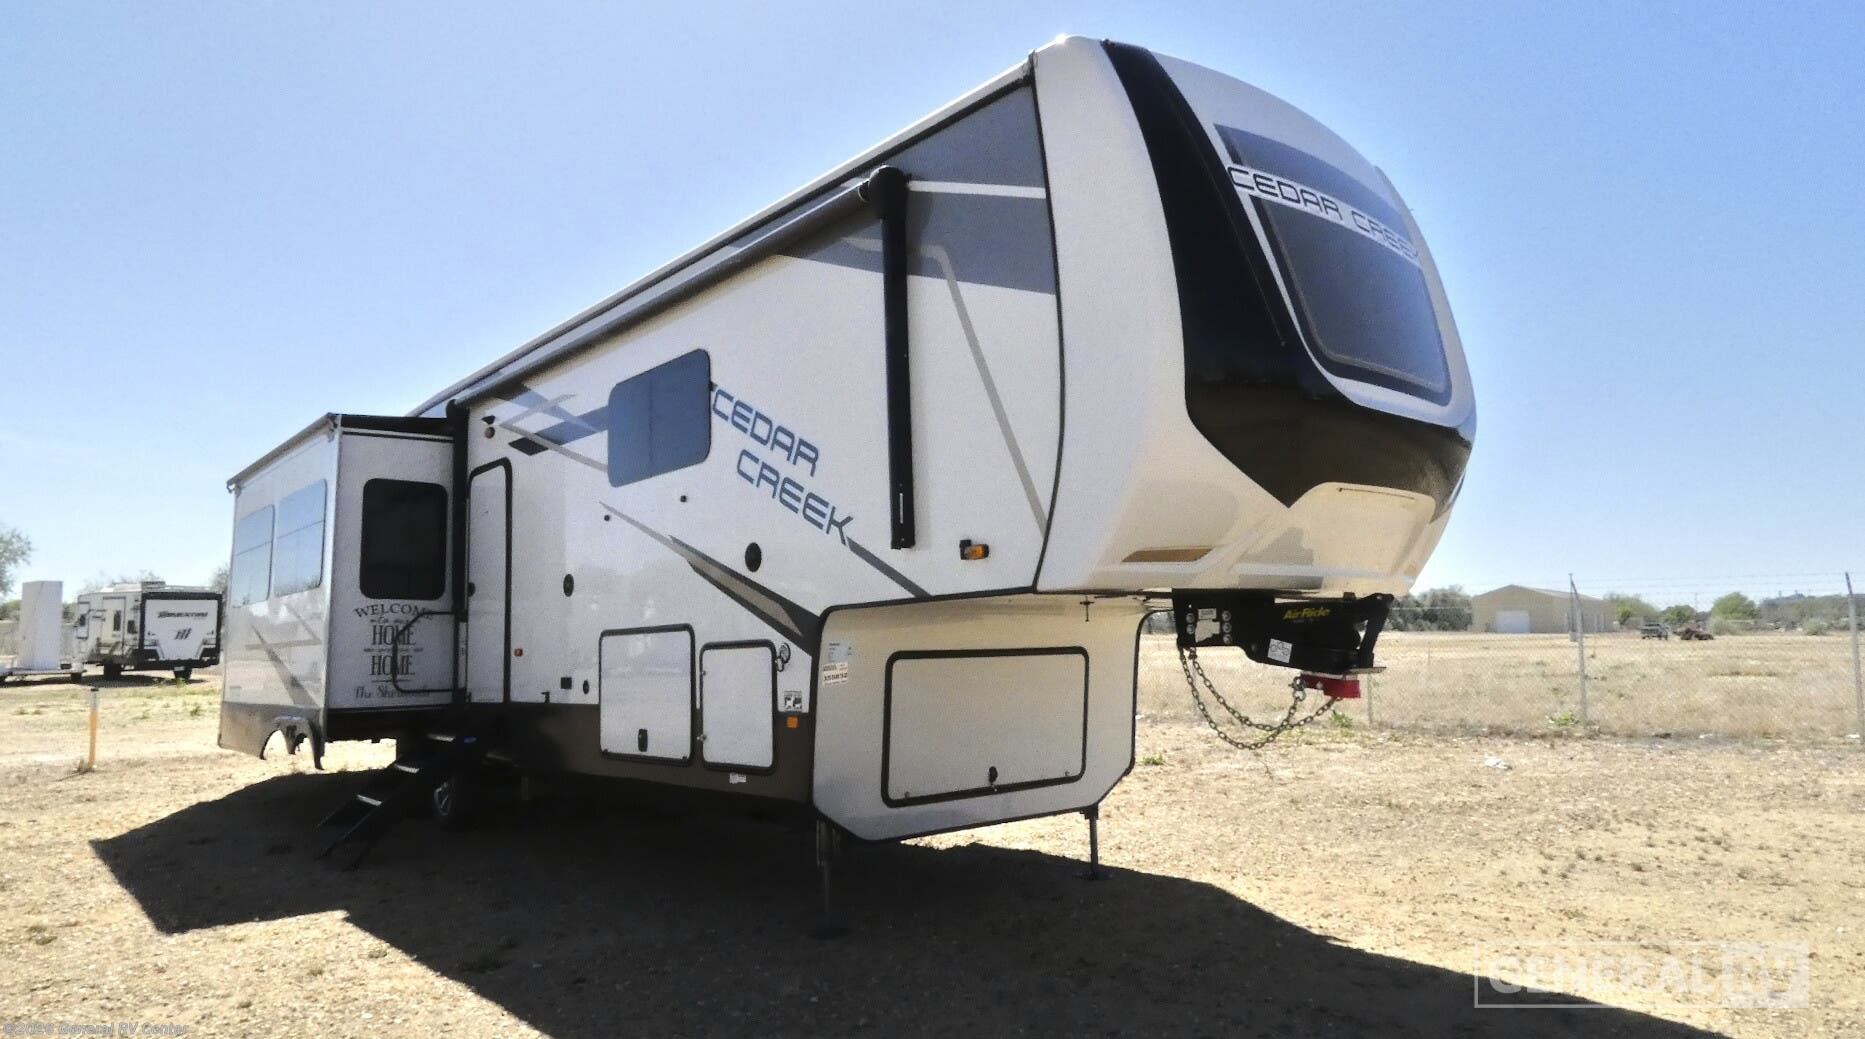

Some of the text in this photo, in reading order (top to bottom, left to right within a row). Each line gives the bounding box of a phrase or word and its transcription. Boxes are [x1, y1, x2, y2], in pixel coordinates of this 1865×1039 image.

[1226, 165, 1344, 221] CEDAR
[712, 388, 820, 478] CEDAR
[736, 449, 854, 546] CREEK
